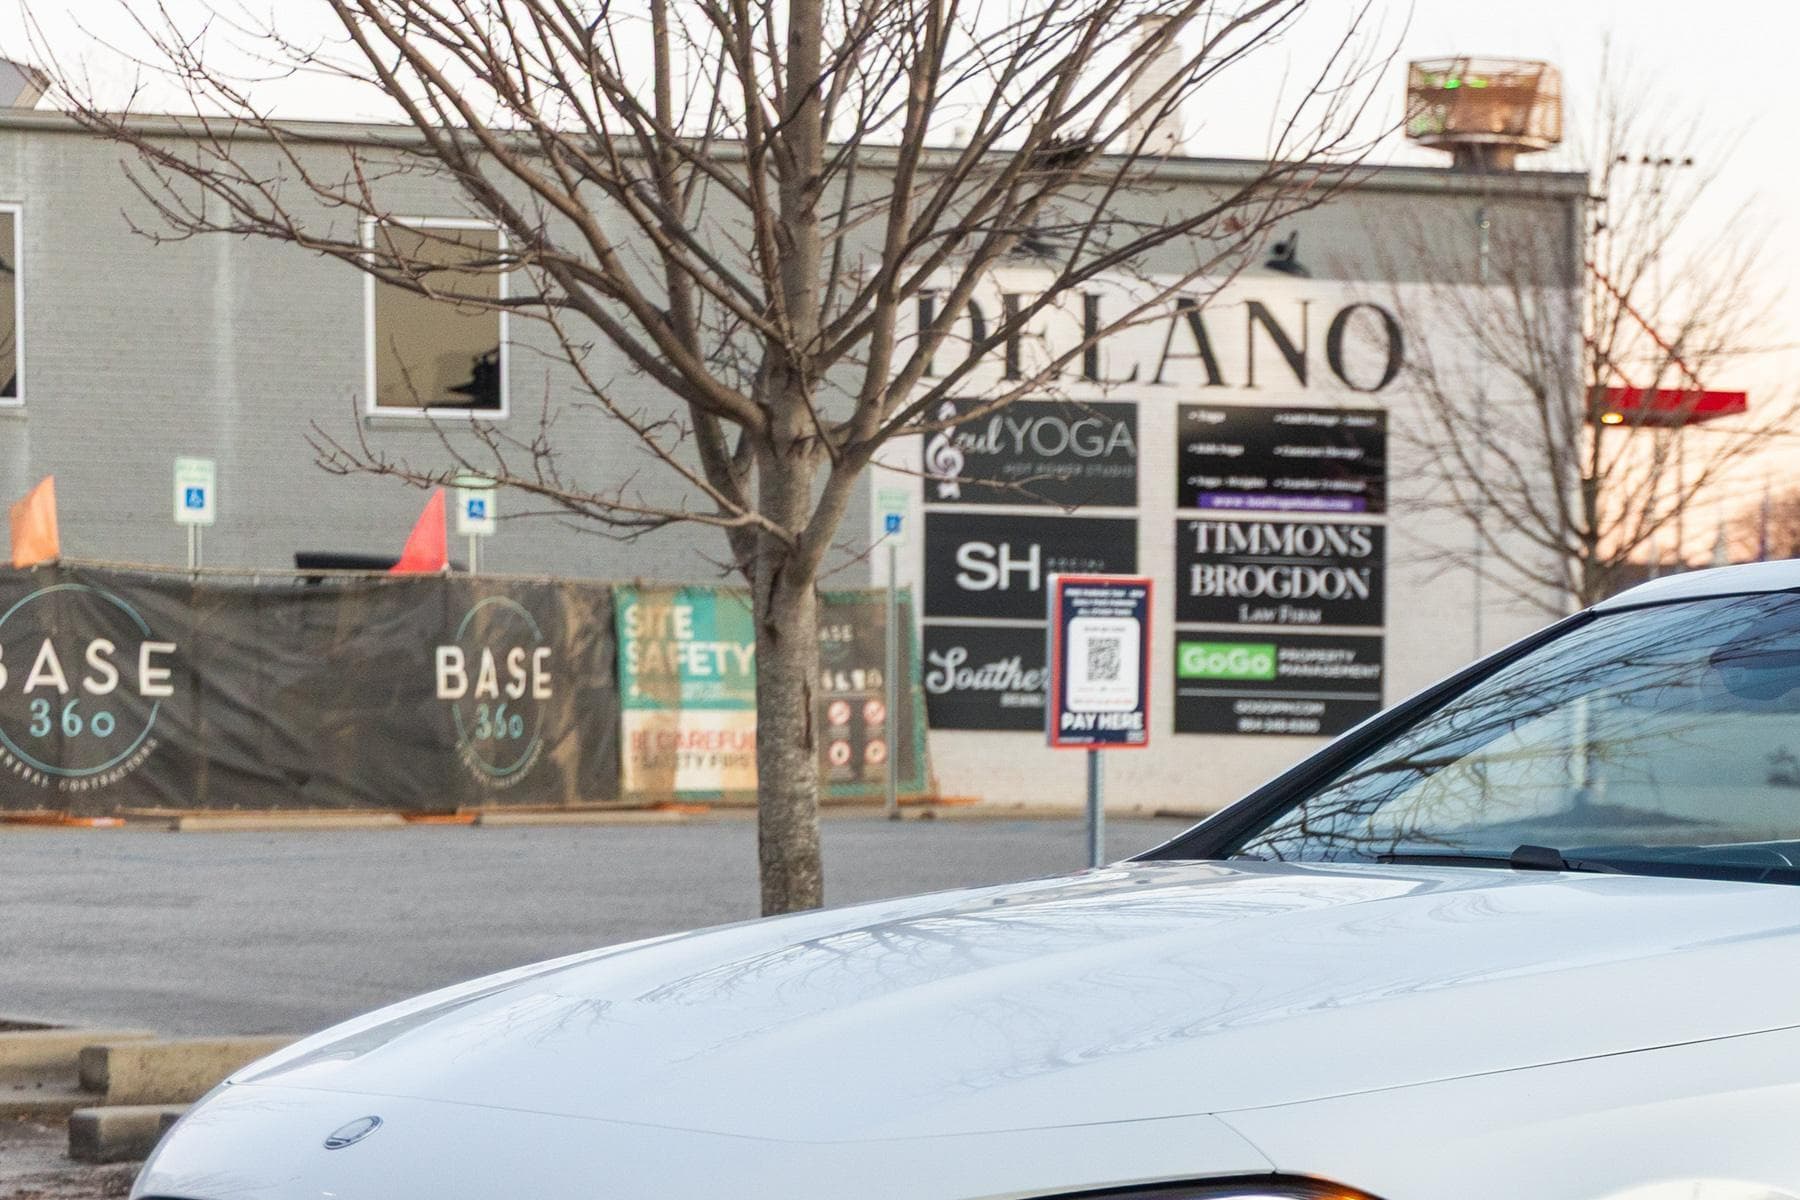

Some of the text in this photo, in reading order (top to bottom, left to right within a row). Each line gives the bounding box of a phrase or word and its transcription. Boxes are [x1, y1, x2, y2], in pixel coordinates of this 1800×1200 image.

[916, 287, 1403, 392] DELANO
[1006, 415, 1137, 458] YOGA
[1189, 521, 1373, 557] TIMMONS
[956, 541, 1041, 591] SH
[1190, 564, 1371, 600] BROGDON
[623, 604, 694, 641] SITE
[0, 637, 178, 696] ASE
[436, 645, 553, 699] BASE
[624, 641, 756, 676] SAFETY
[1182, 646, 1272, 674] GoGo
[29, 698, 116, 738] 360
[475, 703, 524, 740] 360
[1061, 712, 1144, 731] PAY HERE
[656, 730, 757, 750] CAREFU
